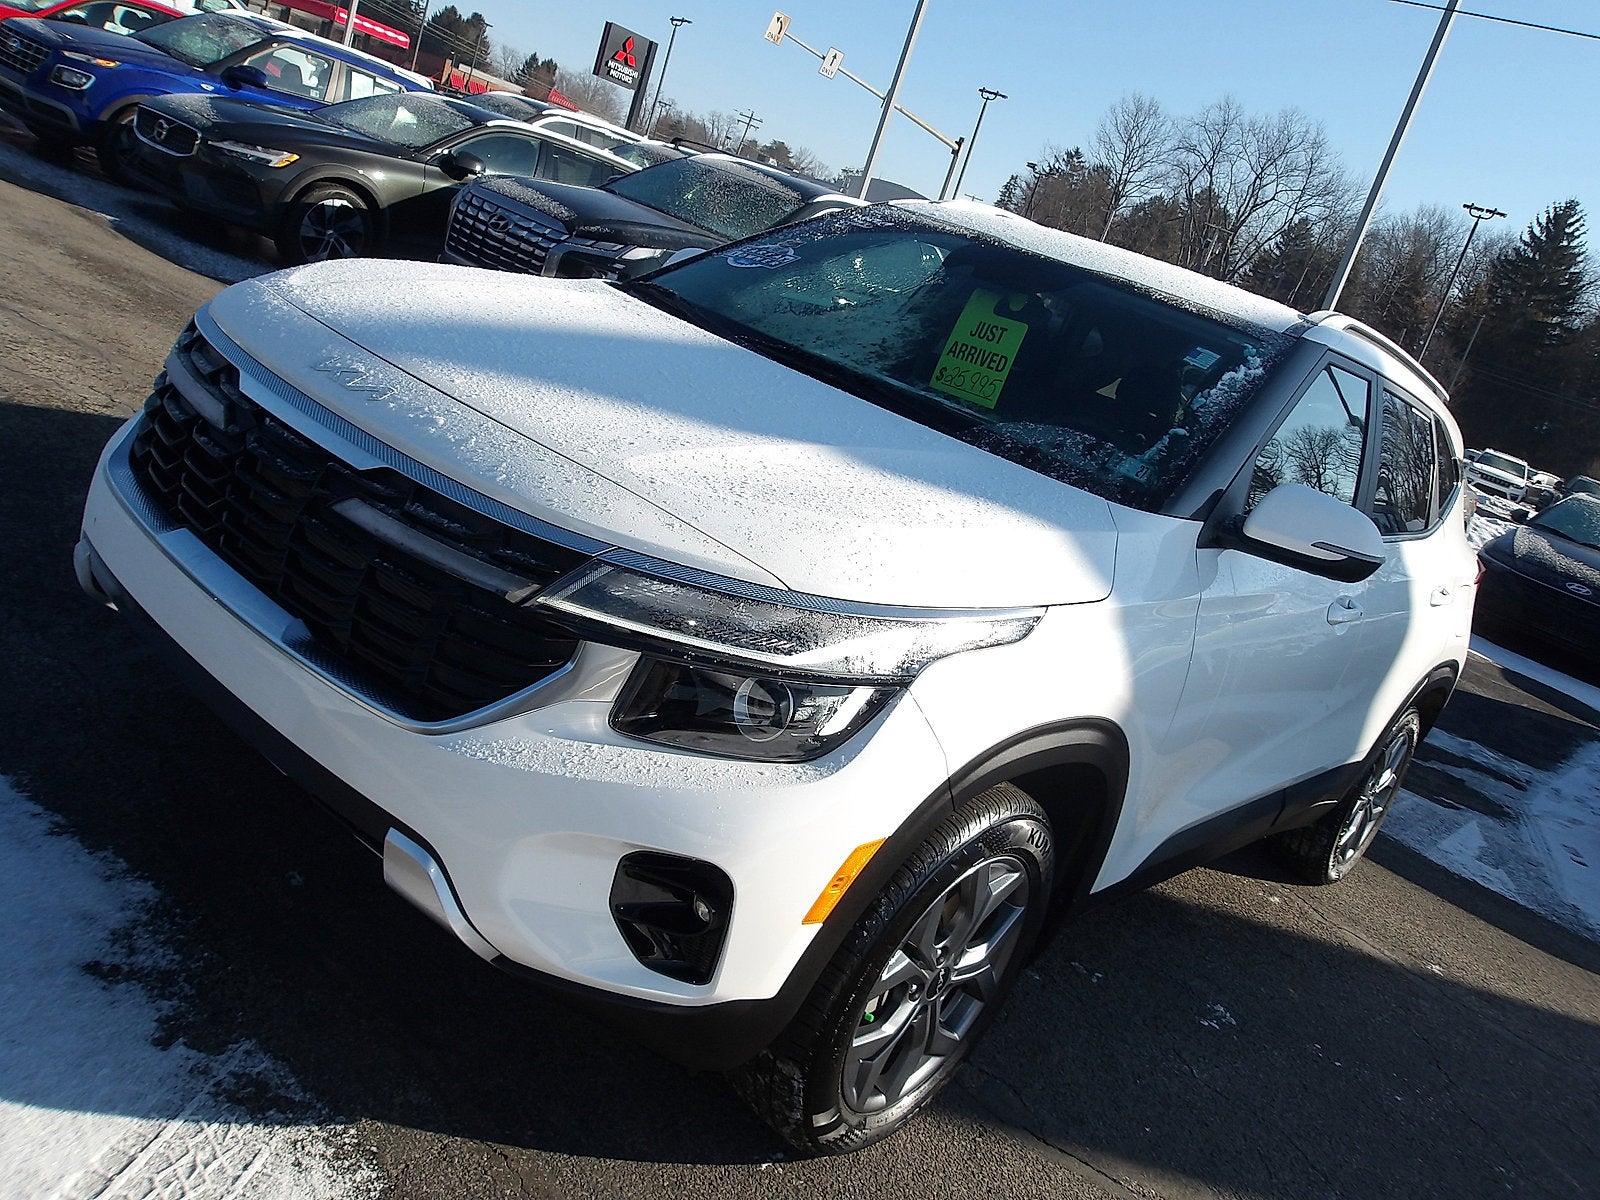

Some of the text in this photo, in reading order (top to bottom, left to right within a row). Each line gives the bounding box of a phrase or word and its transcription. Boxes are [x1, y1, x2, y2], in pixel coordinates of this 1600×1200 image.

[767, 31, 780, 42] ONLY
[607, 60, 639, 79] MITSUBISHI
[610, 69, 633, 84] MOTORS
[821, 66, 834, 77] ONLY
[969, 321, 1008, 344] JUST
[946, 340, 1008, 373] ARRIVED
